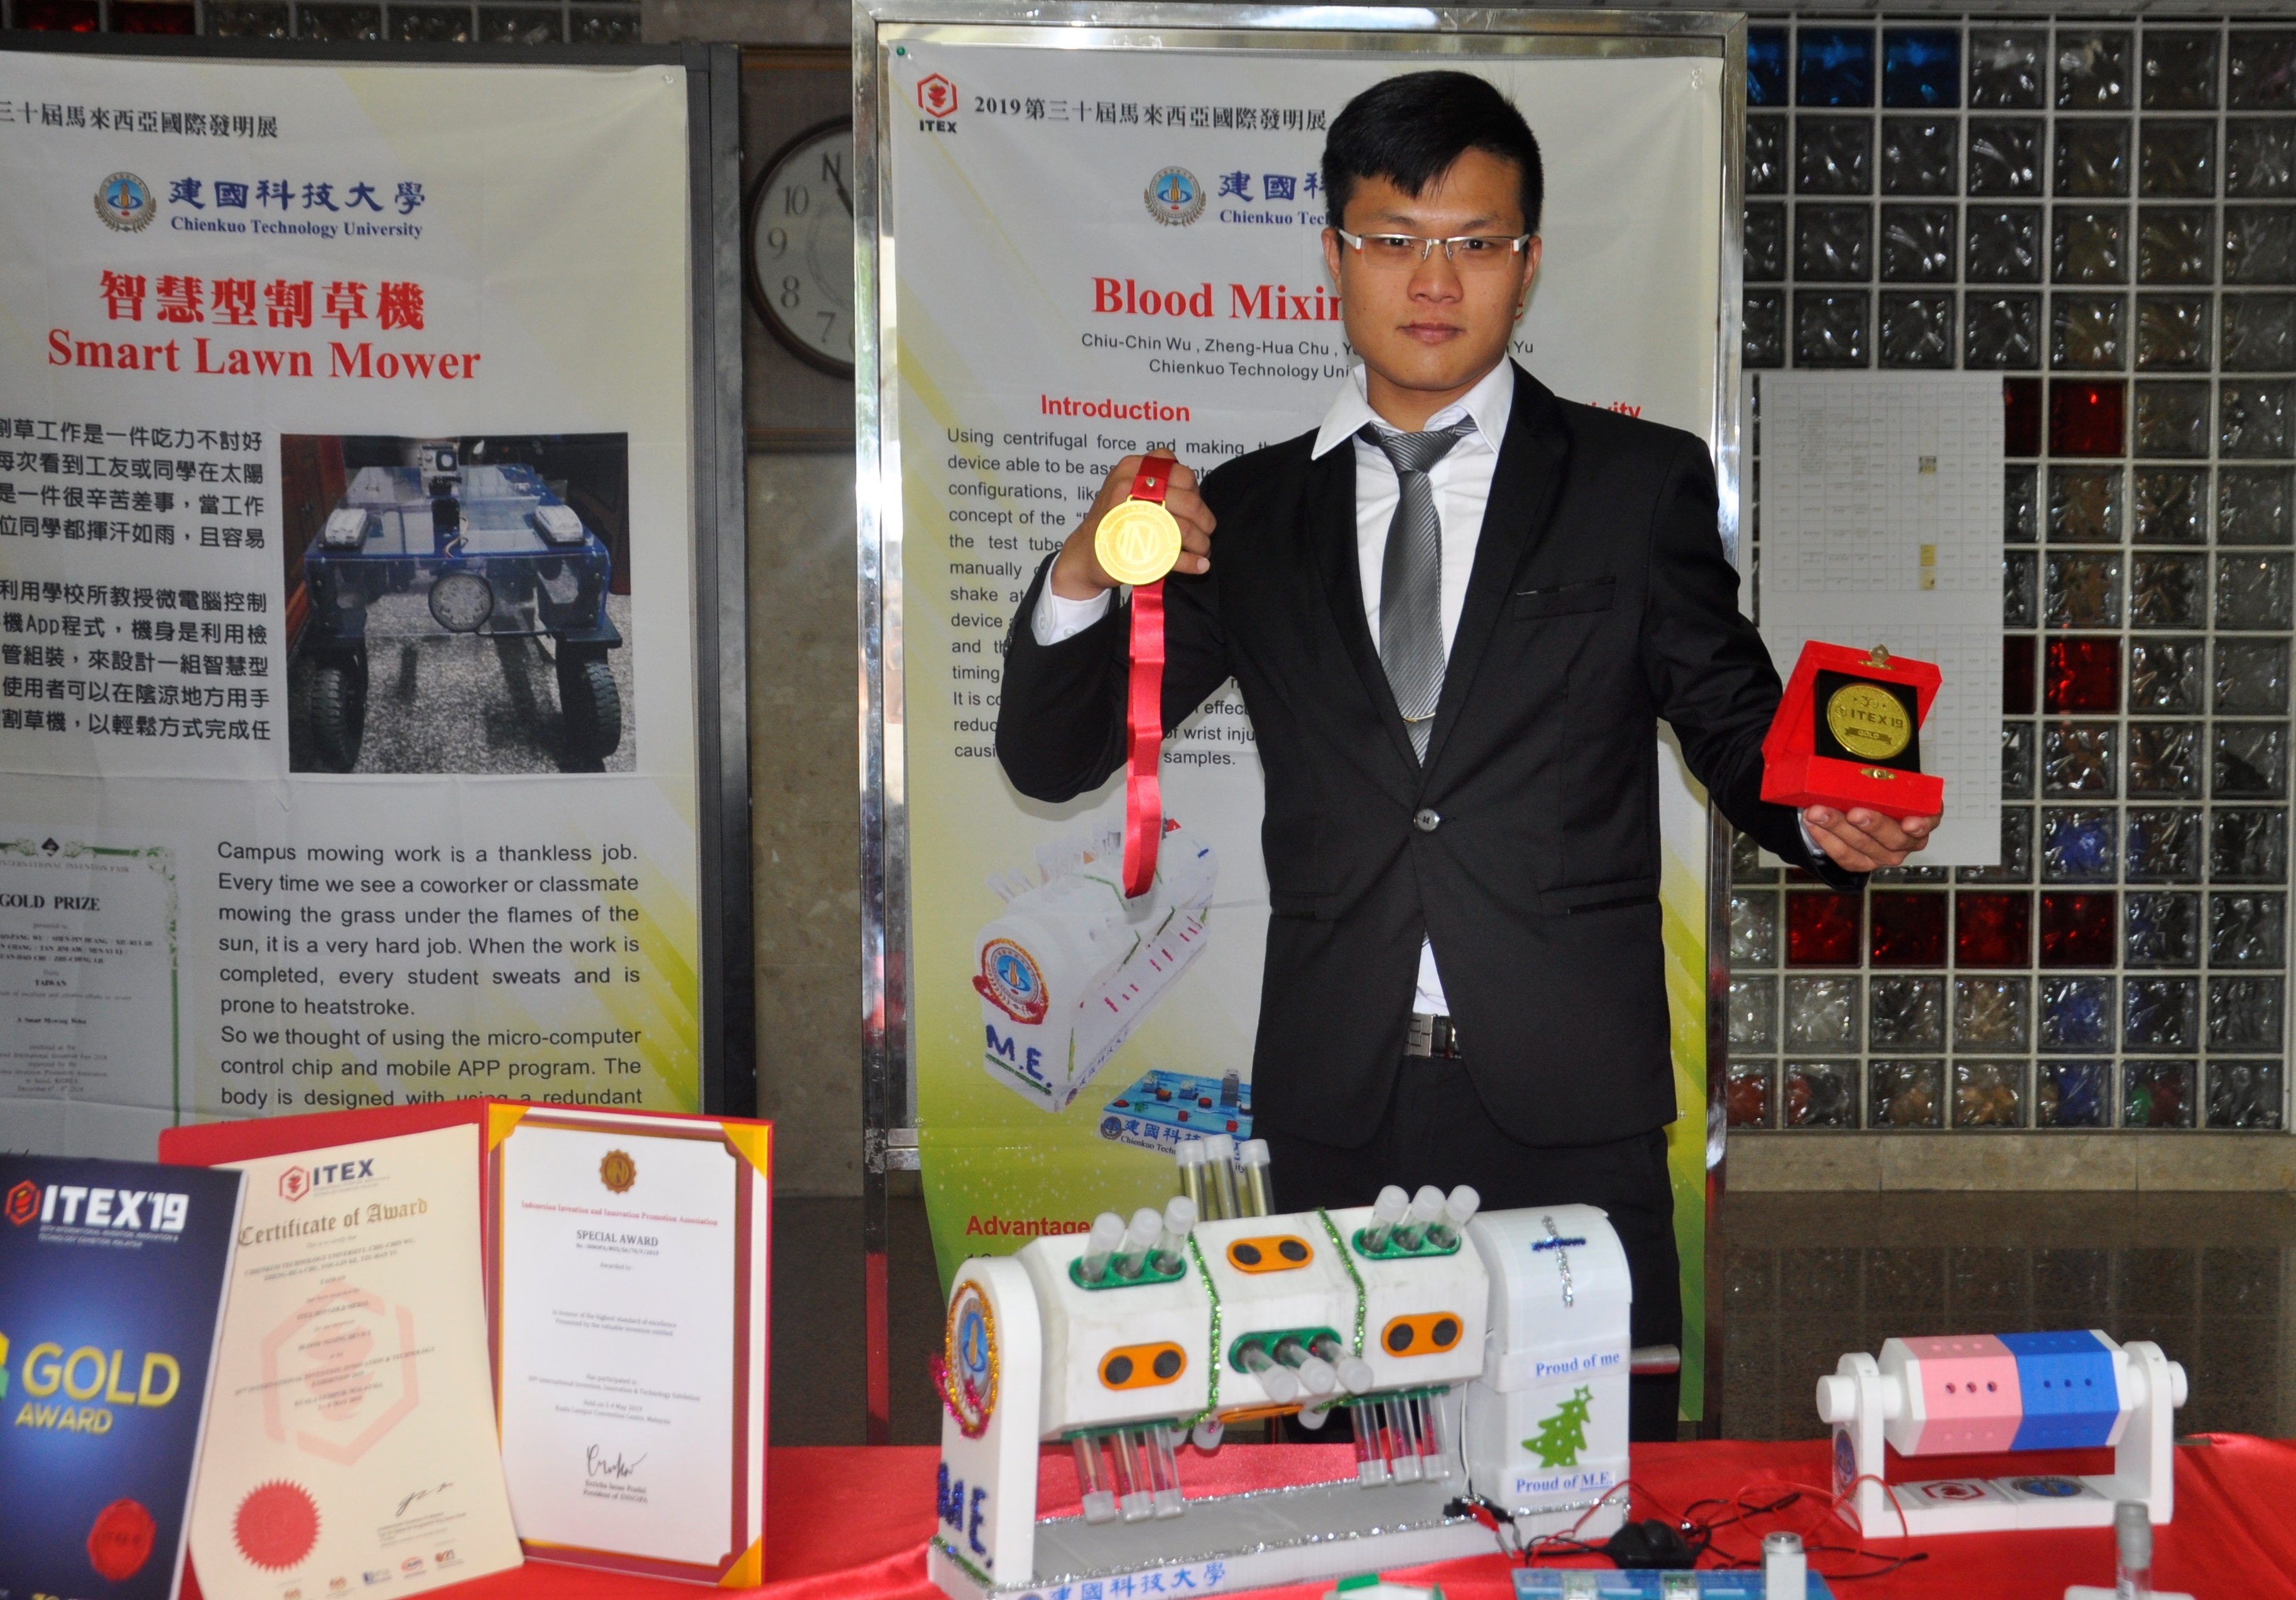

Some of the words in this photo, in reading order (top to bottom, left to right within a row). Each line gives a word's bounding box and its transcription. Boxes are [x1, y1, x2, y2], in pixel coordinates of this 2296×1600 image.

[919, 119, 957, 134] ITEX
[168, 177, 425, 215] 建國科技大學
[785, 185, 809, 217] 10
[170, 216, 246, 233] Chienkuo
[250, 219, 338, 239] Technology
[344, 222, 422, 240] University
[1219, 210, 1293, 224] Chienkuo
[768, 226, 786, 259] 9
[100, 269, 425, 330] 智慧型割草機
[780, 275, 800, 308] 8
[1093, 277, 1214, 318] Blood
[818, 311, 836, 343] 7
[48, 329, 180, 372] Smart
[194, 337, 313, 377] Lawn
[329, 342, 481, 379] Mower
[1081, 333, 1162, 350] Chiu-Chin
[1166, 337, 1191, 351] Wu
[1205, 338, 1293, 357] Zheng-Hua
[1298, 341, 1329, 356] Chu
[1514, 340, 1533, 354] Yu
[1149, 359, 1225, 375] Chienkuo
[1229, 362, 1319, 381] Technology
[1042, 394, 1190, 422] Introduction
[947, 428, 994, 447] Using
[1003, 432, 1087, 451] centrifugal
[1096, 434, 1136, 451] force
[1186, 440, 1244, 455] making
[947, 454, 1001, 471] device
[1006, 457, 1040, 472] able
[1045, 459, 1060, 473] to
[1065, 459, 1085, 474] be
[949, 481, 1067, 501] configurations,
[949, 509, 1013, 526] concept
[1019, 509, 1035, 525] of
[1040, 510, 1065, 526] the
[949, 533, 974, 548] the
[988, 535, 1018, 550] test
[950, 562, 1022, 580] manually
[950, 586, 998, 602] shake
[951, 612, 1003, 628] device
[952, 639, 981, 653] and
[952, 664, 1001, 683] timing
[954, 691, 964, 705] It
[968, 691, 981, 705] is
[1182, 726, 1222, 741] wrist
[1858, 730, 1880, 739] GOLD
[1164, 751, 1236, 767] samples.
[217, 841, 297, 864] Campus
[307, 844, 384, 866] mowing
[394, 845, 441, 862] work
[451, 846, 465, 863] is
[498, 844, 592, 862] thankless
[601, 843, 637, 865] job.
[219, 872, 273, 895] Every
[279, 874, 319, 892] time
[325, 879, 354, 893] we
[361, 879, 396, 893] see
[420, 876, 509, 894] coworker
[514, 879, 534, 893] or
[539, 875, 639, 893] classmate
[0, 893, 45, 908] GOLD
[54, 896, 100, 912] PRIZE
[219, 905, 291, 926] mowing
[300, 906, 332, 923] the
[340, 910, 396, 927] grass
[405, 907, 461, 924] under
[468, 907, 498, 925] the
[507, 906, 572, 923] flames
[582, 905, 601, 922] of
[609, 905, 639, 922] the
[219, 938, 259, 955] sun,
[267, 935, 278, 952] it
[283, 935, 299, 953] is
[325, 940, 369, 957] very
[376, 937, 420, 954] hard
[426, 937, 462, 958] job.
[469, 937, 525, 955] When
[532, 937, 563, 954] the
[570, 936, 617, 953] work
[624, 935, 639, 952] is
[219, 966, 324, 988] completed,
[339, 971, 394, 989] every
[408, 968, 479, 986] student
[492, 968, 560, 985] sweats
[574, 967, 610, 984] and
[624, 966, 640, 983] is
[220, 998, 275, 1016] prone
[280, 997, 298, 1014] to
[304, 997, 415, 1015] heatstroke.
[221, 1025, 247, 1043] So
[253, 1031, 280, 1045] we
[285, 1028, 361, 1050] thought
[366, 1029, 386, 1046] of
[392, 1029, 445, 1050] using
[451, 1029, 481, 1047] the
[487, 1028, 642, 1048] micro-computer
[220, 1058, 283, 1075] control
[291, 1059, 333, 1079] chip
[341, 1059, 378, 1076] and
[386, 1059, 451, 1077] mobile
[457, 1060, 500, 1077] APP
[508, 1062, 596, 1080] program.
[604, 1057, 641, 1074] The
[221, 1087, 268, 1110] body
[278, 1088, 293, 1105] is
[304, 1089, 394, 1111] designed
[405, 1089, 445, 1104] with
[543, 1089, 643, 1106] redundant
[1121, 1135, 1155, 1150] Chienkuo
[313, 1158, 374, 1185] ITEX
[40, 1185, 189, 1232] ITEX'19
[238, 1215, 336, 1246] Certificate
[343, 1207, 359, 1227] of
[366, 1198, 428, 1224] Award
[577, 1229, 617, 1243] SPECIAL
[619, 1233, 658, 1247] AWARD
[22, 1342, 180, 1408] GOLD
[1535, 1358, 1579, 1376] Proud
[1582, 1355, 1597, 1371] of
[1601, 1354, 1620, 1368] me
[15, 1401, 113, 1434] AWARD
[1517, 1476, 1559, 1493] Proud
[1563, 1475, 1577, 1490] of
[1580, 1471, 1614, 1491] M.E.
